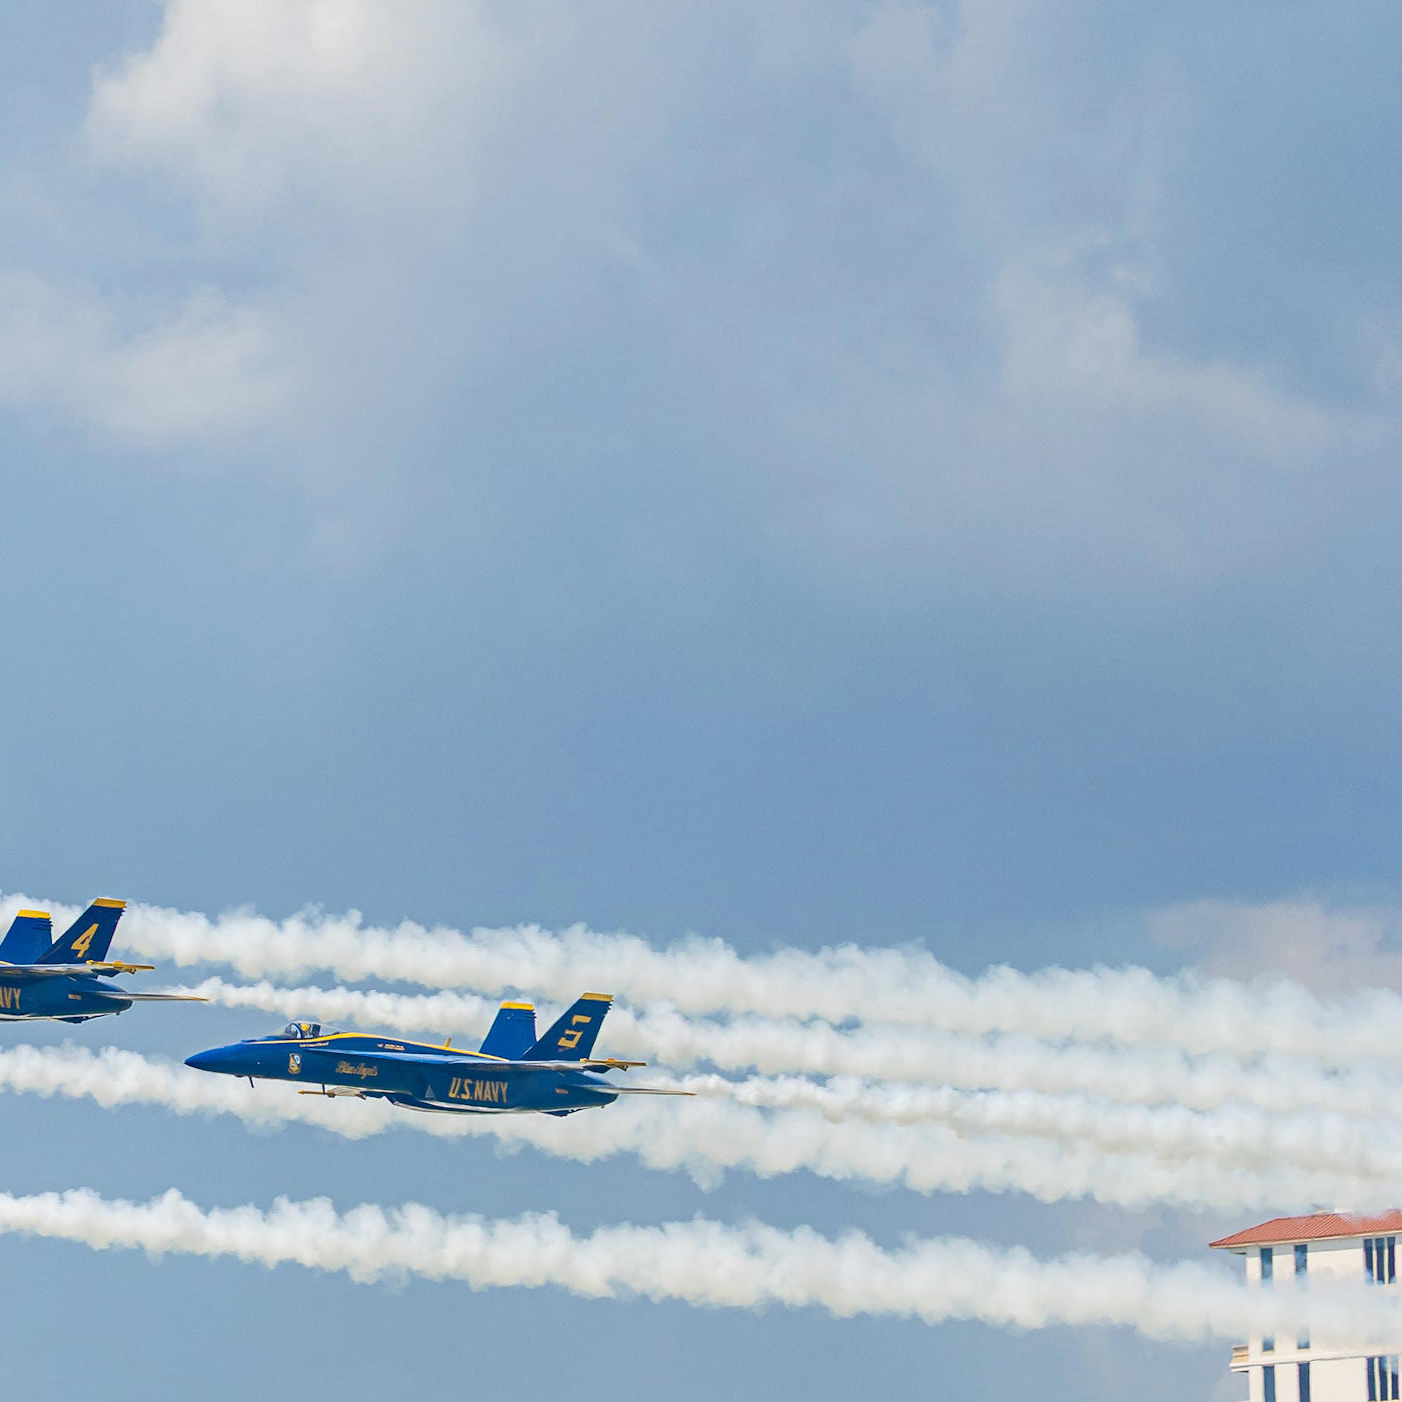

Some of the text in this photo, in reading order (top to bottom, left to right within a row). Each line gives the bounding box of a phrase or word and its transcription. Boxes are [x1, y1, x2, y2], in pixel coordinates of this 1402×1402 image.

[70, 923, 100, 958] 4
[557, 1014, 592, 1048] 5
[335, 1060, 354, 1073] Blue
[448, 1077, 508, 1104] U.S. NAVY
